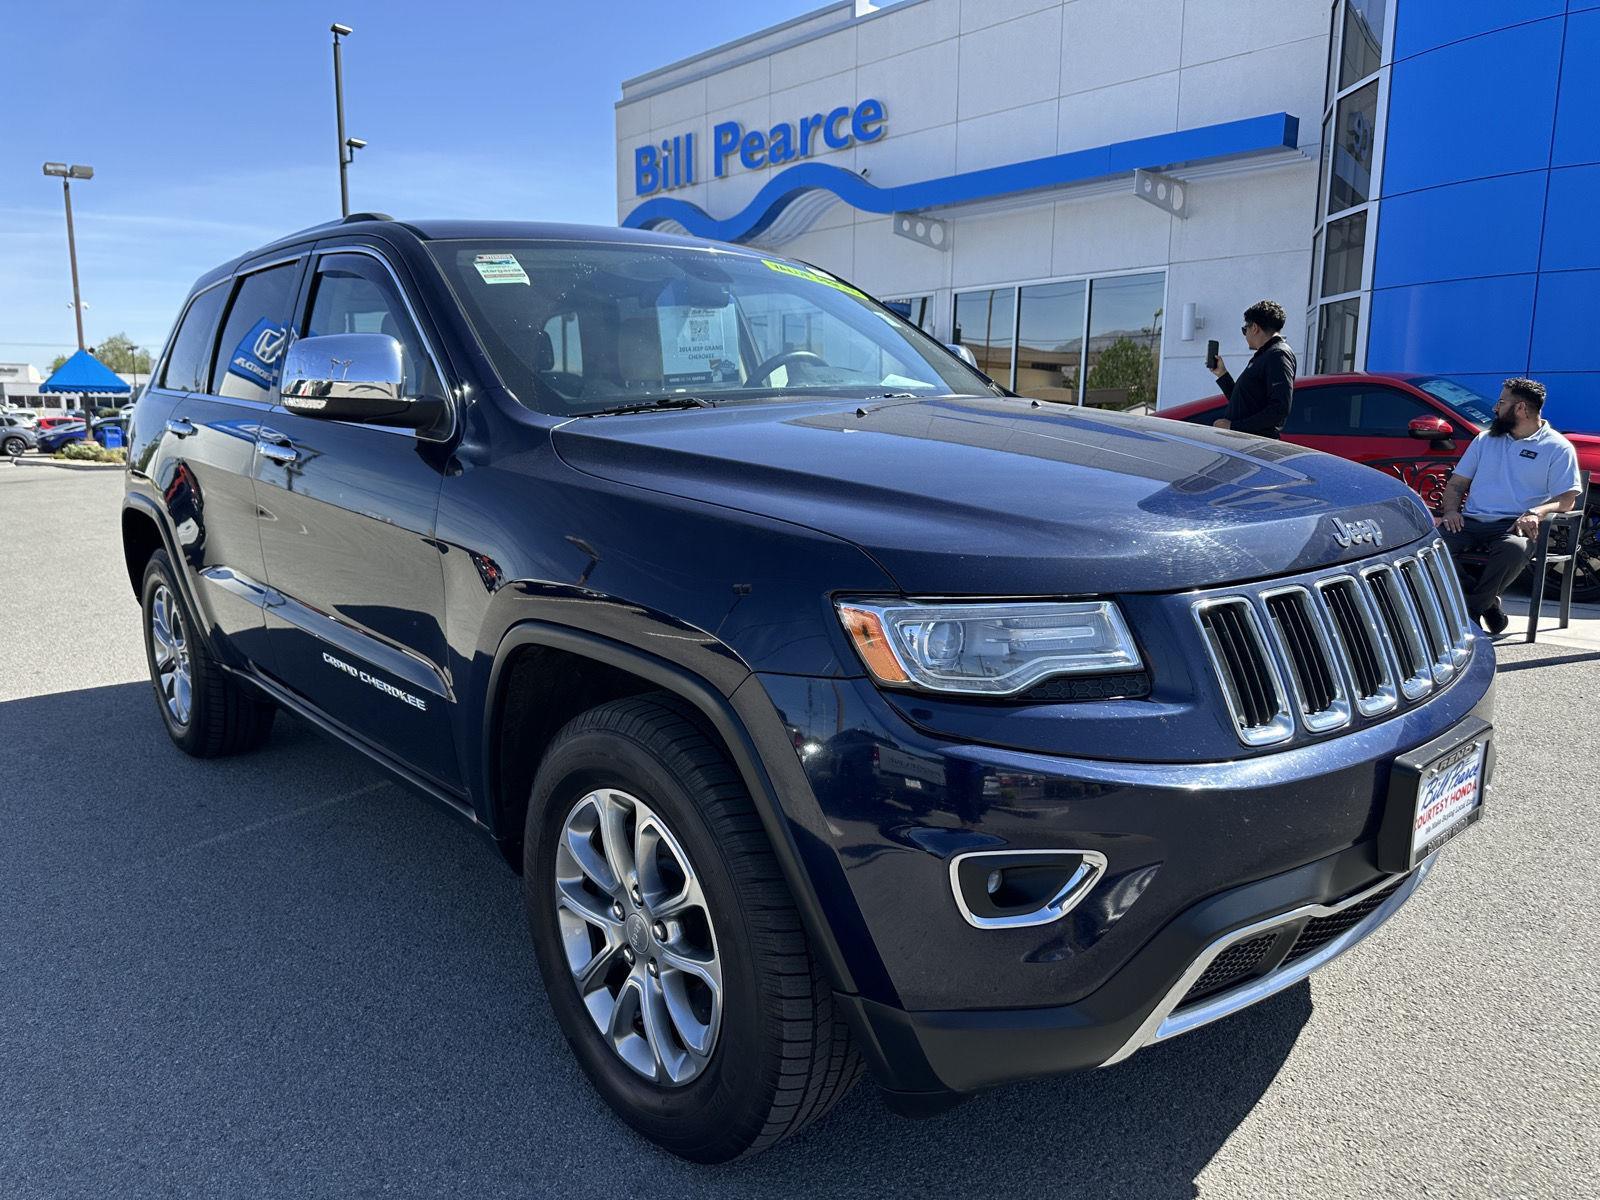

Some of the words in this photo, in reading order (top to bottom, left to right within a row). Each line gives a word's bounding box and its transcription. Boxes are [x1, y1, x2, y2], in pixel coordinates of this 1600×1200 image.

[634, 131, 695, 196] Bill
[713, 98, 887, 178] Pearce
[1331, 517, 1383, 549] Jeep
[322, 652, 359, 678] GRAND
[359, 671, 427, 711] CHEROKEE
[1422, 773, 1449, 811] Bill
[1449, 760, 1480, 791] Pearce
[1450, 780, 1478, 804] HONDA
